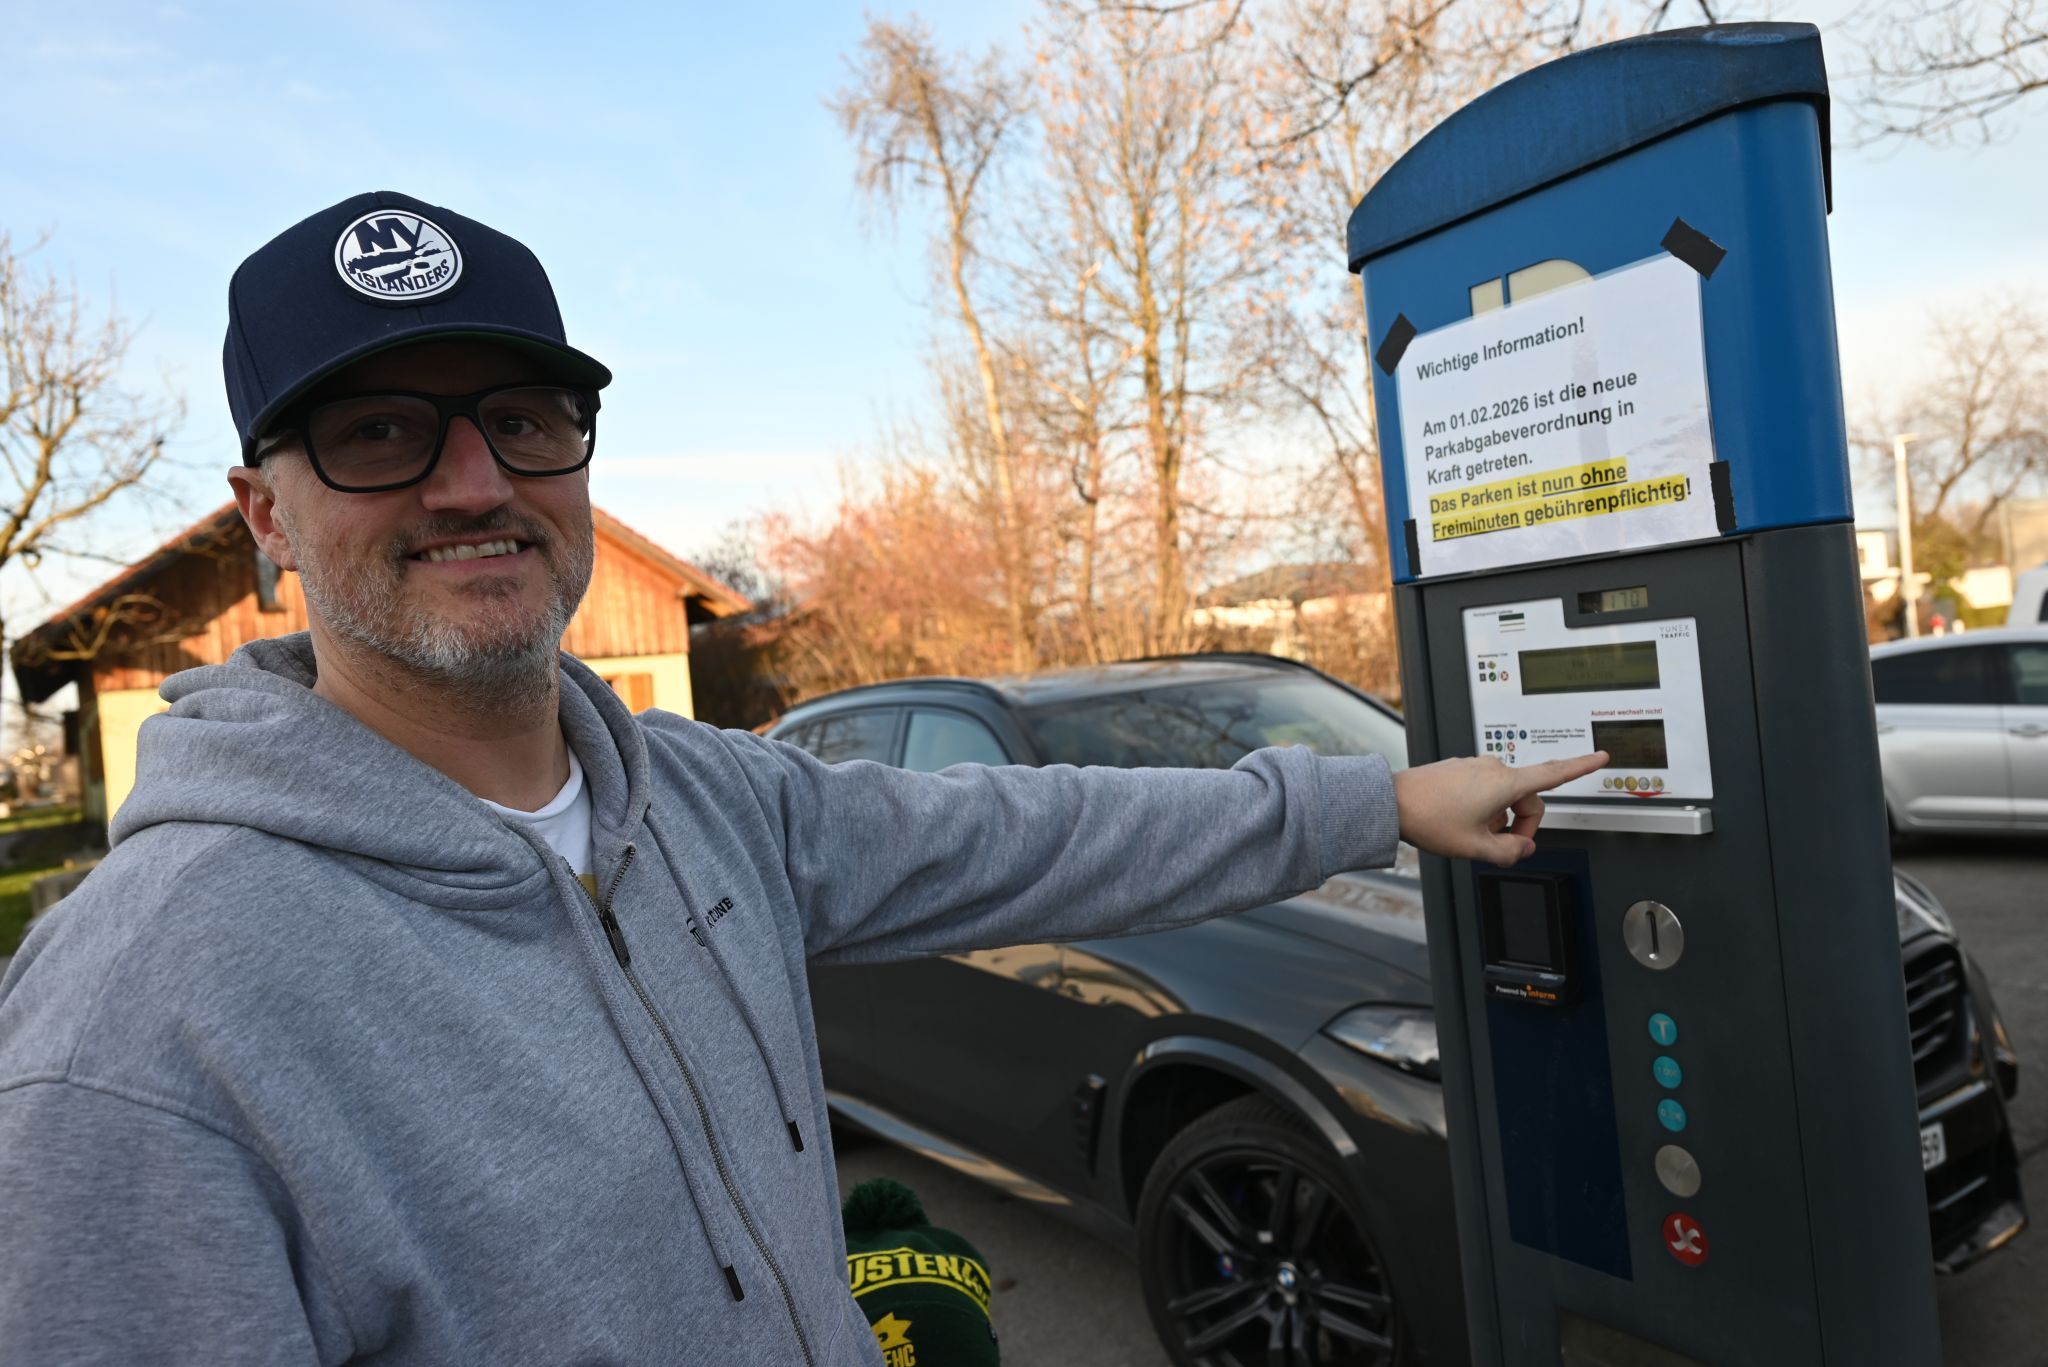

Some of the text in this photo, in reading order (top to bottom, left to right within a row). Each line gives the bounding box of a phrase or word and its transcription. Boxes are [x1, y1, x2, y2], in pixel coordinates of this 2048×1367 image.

[352, 217, 424, 254] NY
[357, 259, 450, 292] ISLANDERS
[1416, 316, 1585, 381] Wichtige Information!
[1423, 372, 1637, 437] Am 01.02.2026 ist die neue
[1425, 400, 1635, 461] Parkabgabeverordnung in
[1427, 452, 1533, 485] Kraft getreten.
[1430, 466, 1627, 515] Das Parken ist nun ohne
[1432, 478, 1692, 540] Freiminuten gebührenpflichtig!
[1659, 624, 1690, 633] YUNEX
[1661, 631, 1690, 639] TRAFFIC
[1590, 707, 1663, 717] Automat wechselt nicht!
[1495, 985, 1519, 996] Powered
[1519, 988, 1528, 998] by
[1656, 1020, 1670, 1041] T
